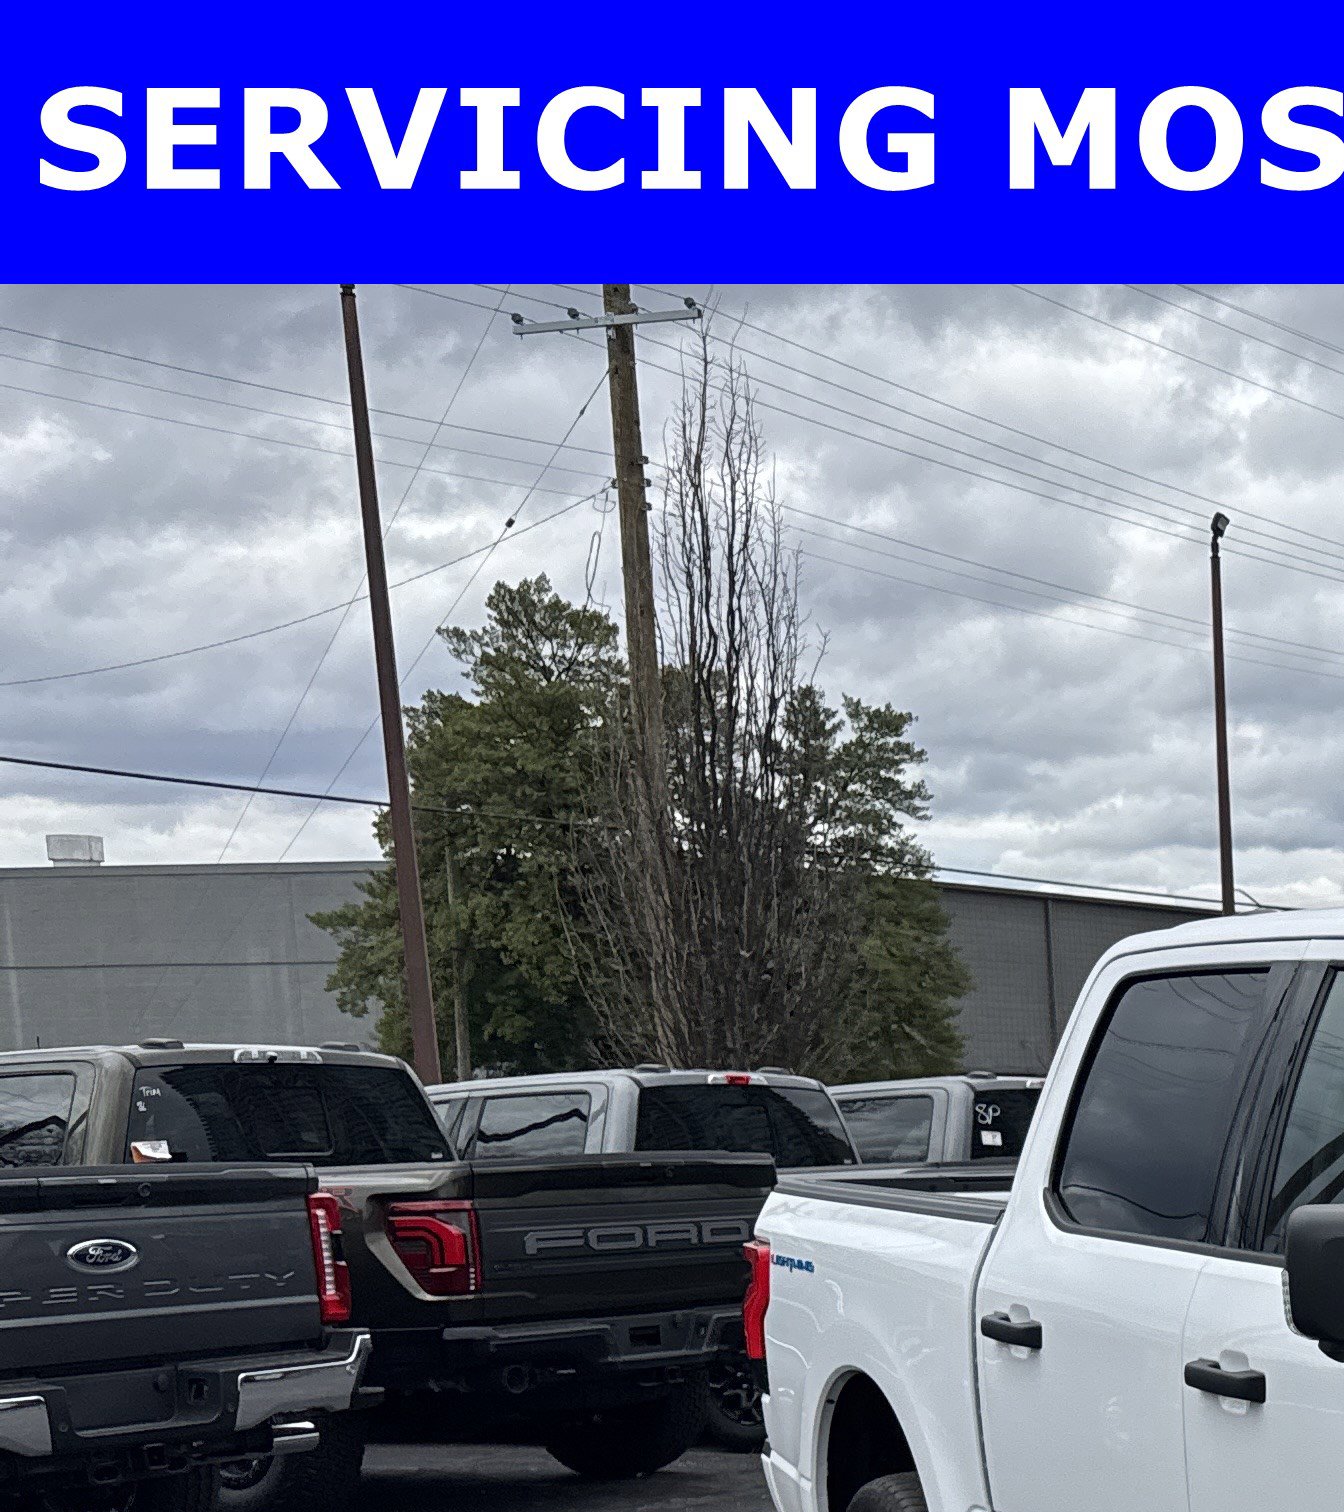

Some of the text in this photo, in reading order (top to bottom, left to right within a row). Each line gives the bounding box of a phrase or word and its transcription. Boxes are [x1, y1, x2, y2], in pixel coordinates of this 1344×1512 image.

[975, 1103, 1001, 1125] 8P
[524, 1218, 750, 1255] FORD
[85, 1245, 123, 1264] Ford
[143, 1270, 296, 1297] DUTY
